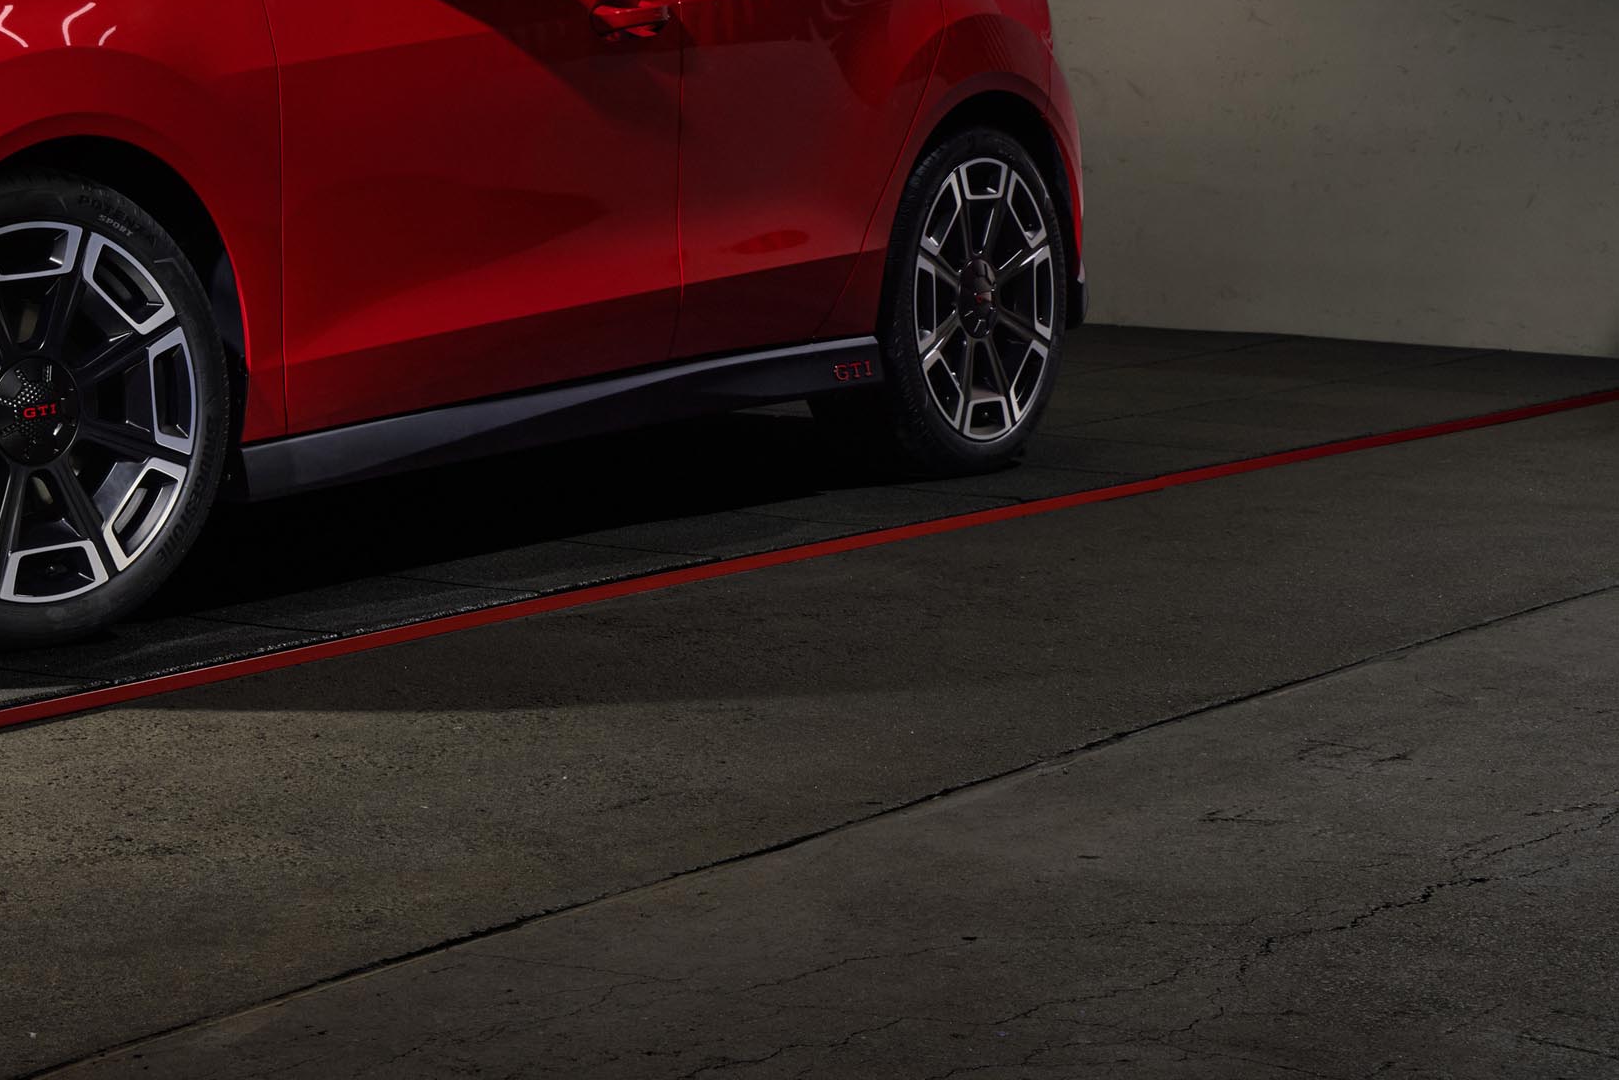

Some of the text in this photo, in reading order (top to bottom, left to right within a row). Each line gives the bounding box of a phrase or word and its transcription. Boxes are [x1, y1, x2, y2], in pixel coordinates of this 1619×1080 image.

[97, 214, 134, 237] SPORT
[833, 359, 874, 382] GTI
[22, 400, 58, 419] GTI
